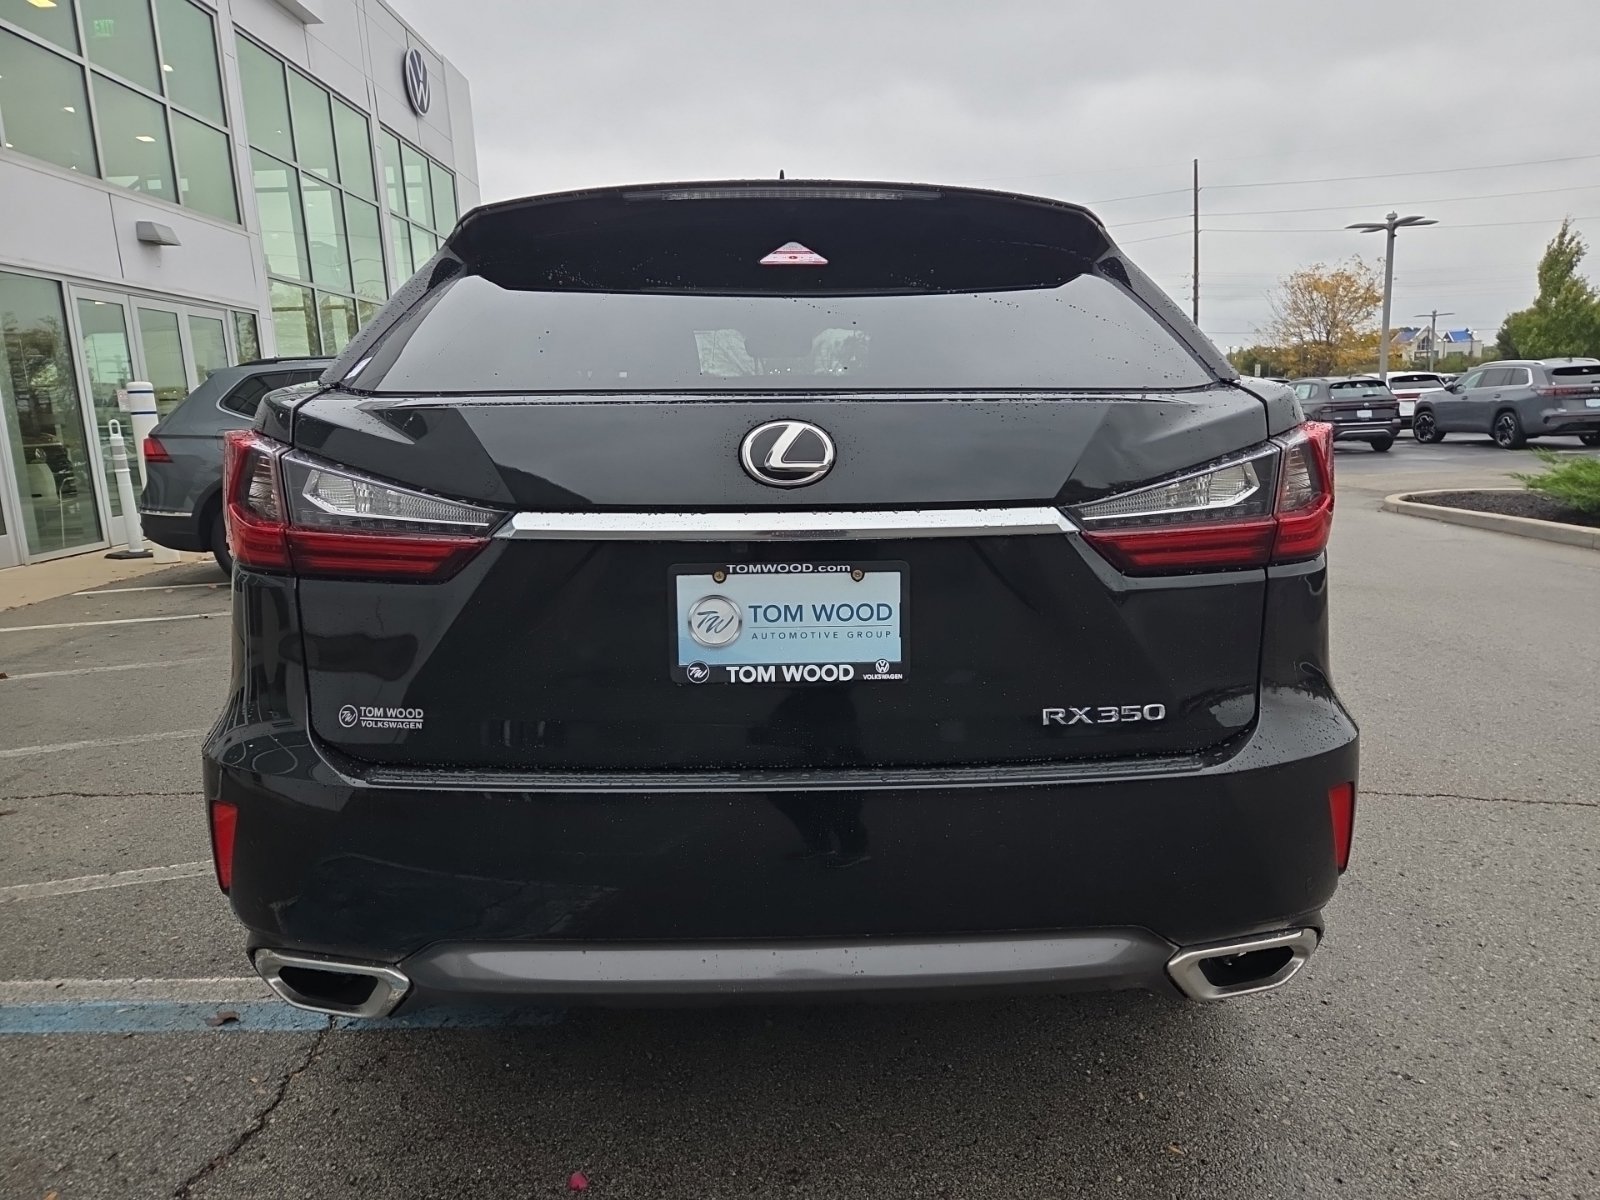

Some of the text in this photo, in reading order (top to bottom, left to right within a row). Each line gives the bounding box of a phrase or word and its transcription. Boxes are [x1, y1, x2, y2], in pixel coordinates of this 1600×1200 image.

[726, 563, 851, 574] TOMWOOD.com
[748, 603, 893, 623] TOM WOOD
[751, 630, 892, 640] AUTOMOTIVE GROUP
[726, 664, 855, 683] TOM WOOD
[360, 706, 424, 718] TOM WOOD
[361, 720, 423, 729] VOLKSWAGEN
